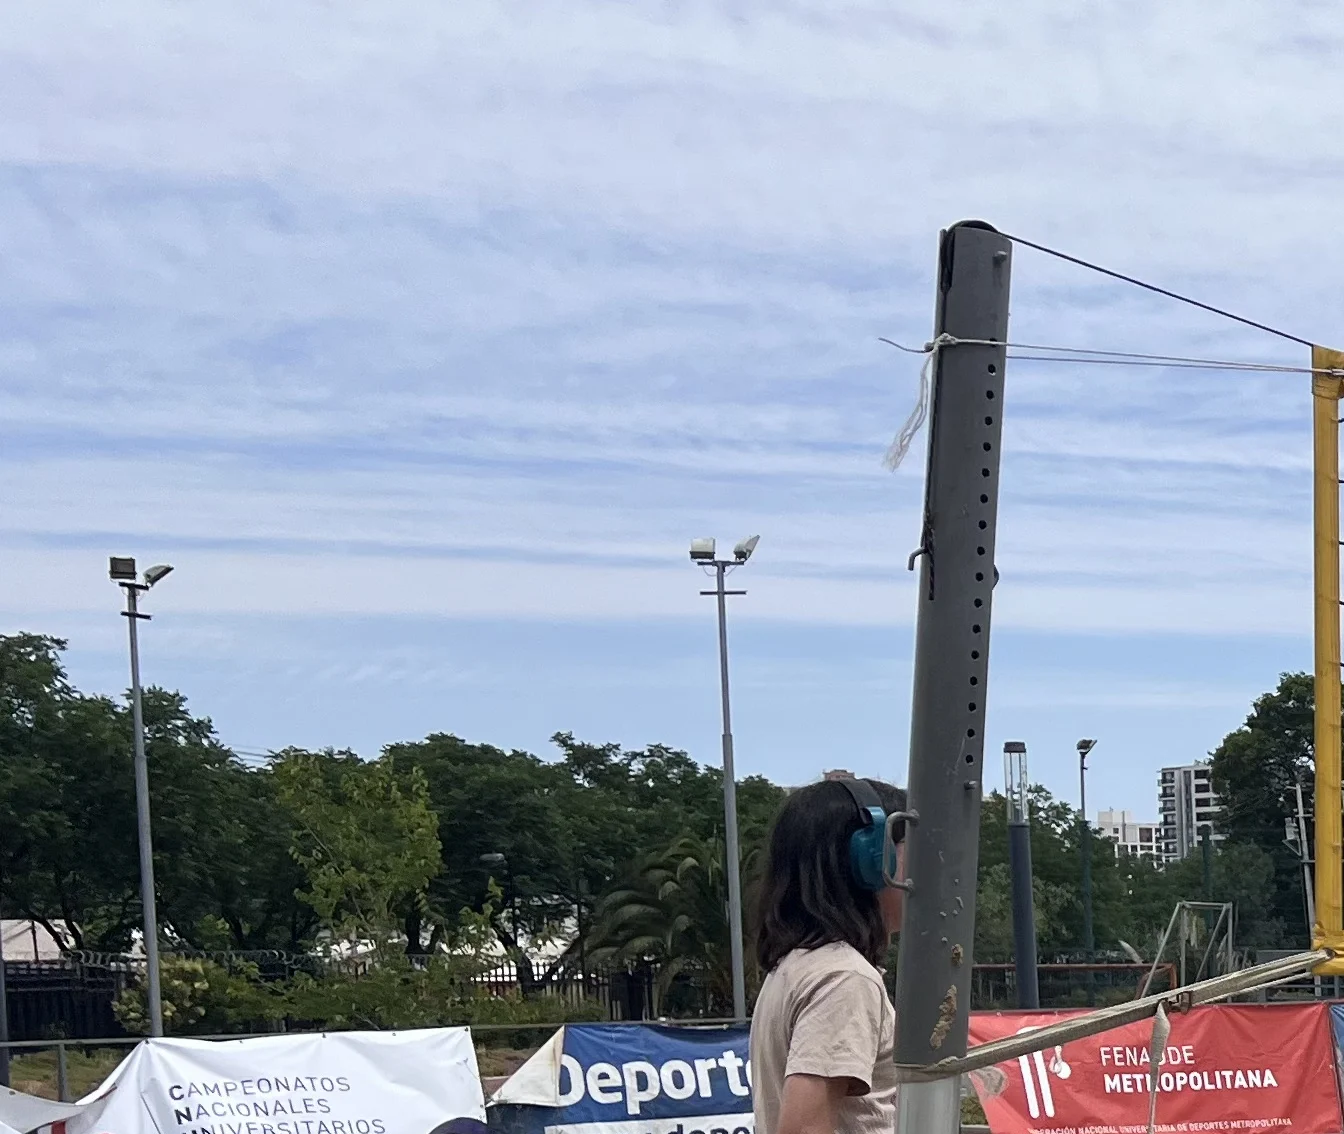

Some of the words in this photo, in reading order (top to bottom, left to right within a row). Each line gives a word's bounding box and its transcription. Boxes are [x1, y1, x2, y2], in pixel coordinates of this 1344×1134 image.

[168, 1076, 351, 1101] CAMPEONATOS
[558, 1049, 752, 1115] Deport
[174, 1098, 331, 1125] NACIONALES
[1119, 1123, 1176, 1134] UNIVERTARIA
[1189, 1121, 1230, 1131] DEPORTES
